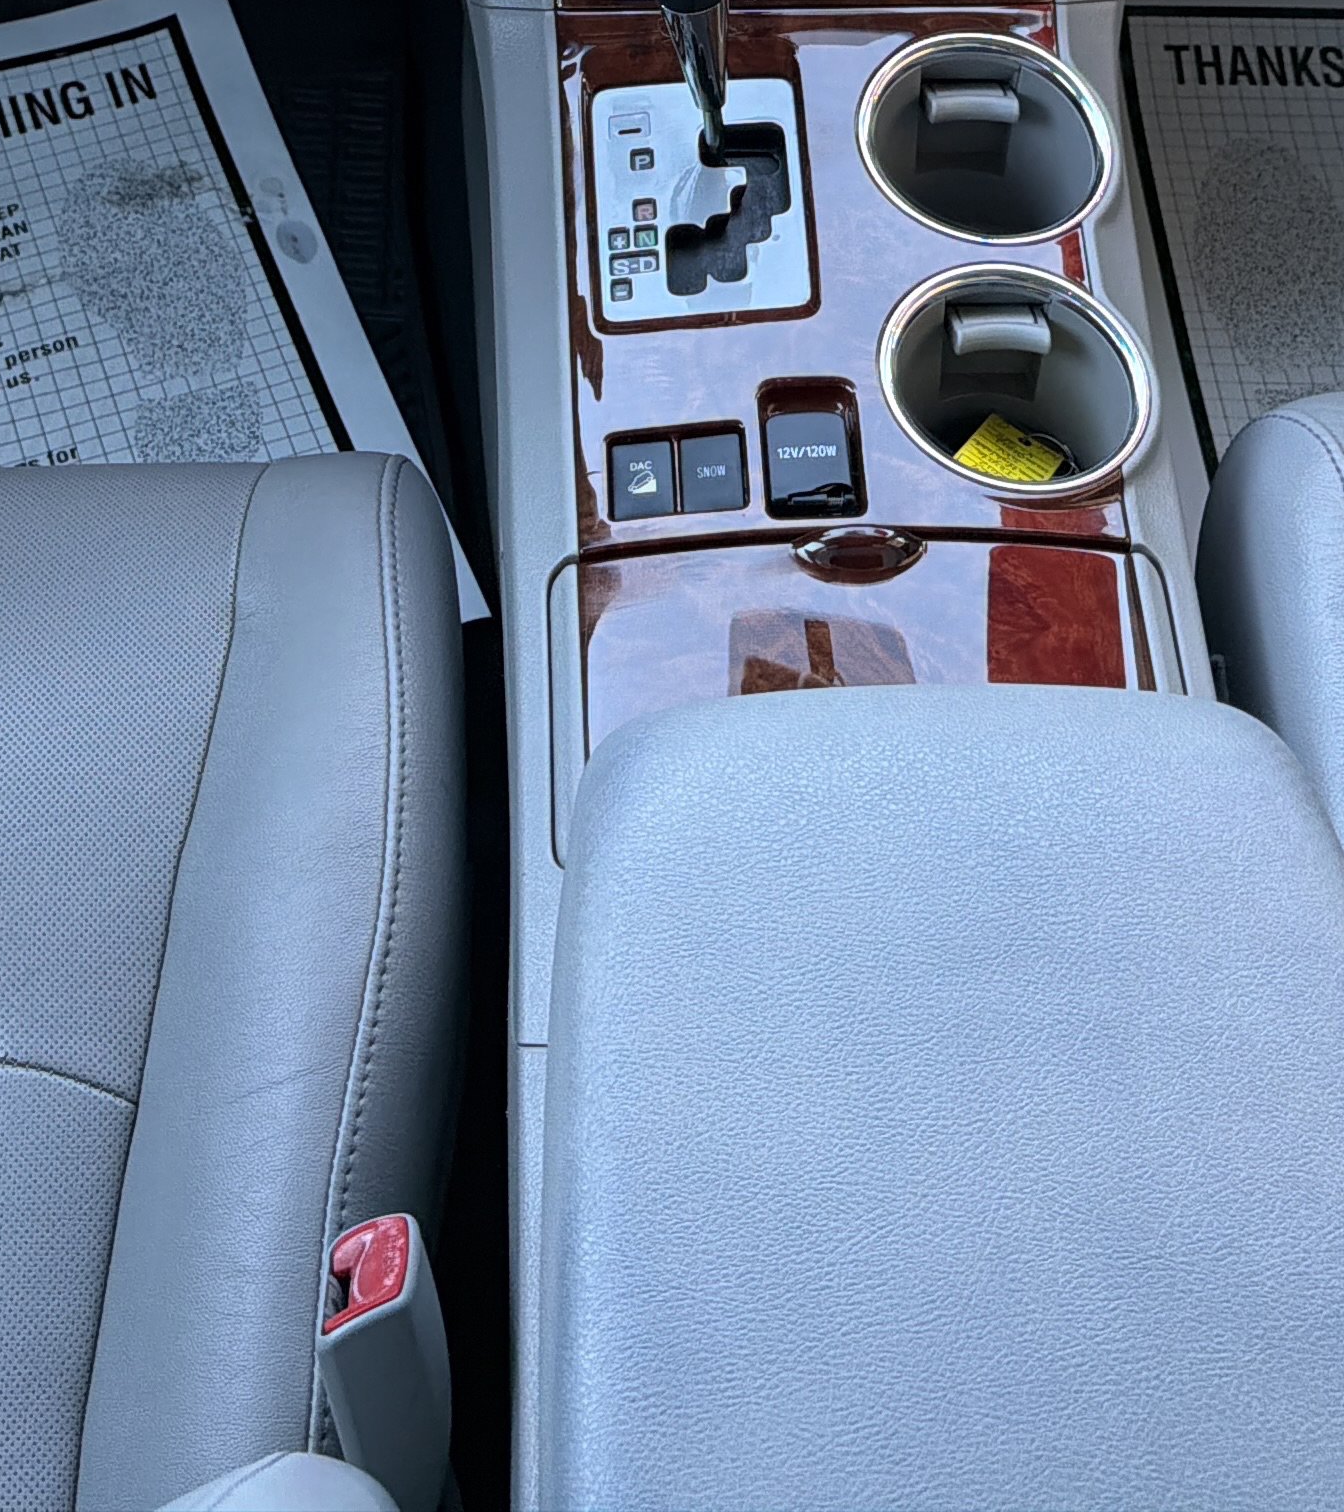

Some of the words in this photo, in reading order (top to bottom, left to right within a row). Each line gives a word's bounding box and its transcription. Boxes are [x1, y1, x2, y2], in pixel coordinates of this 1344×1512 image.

[103, 61, 157, 110] IN
[634, 154, 650, 171] P
[636, 203, 654, 219] R
[638, 231, 655, 246] N
[4, 334, 80, 372] person
[5, 371, 40, 387] us.
[46, 446, 80, 467] for
[776, 444, 837, 460] 12V/120W
[629, 460, 652, 472] DAC
[696, 464, 726, 478] SNOW
